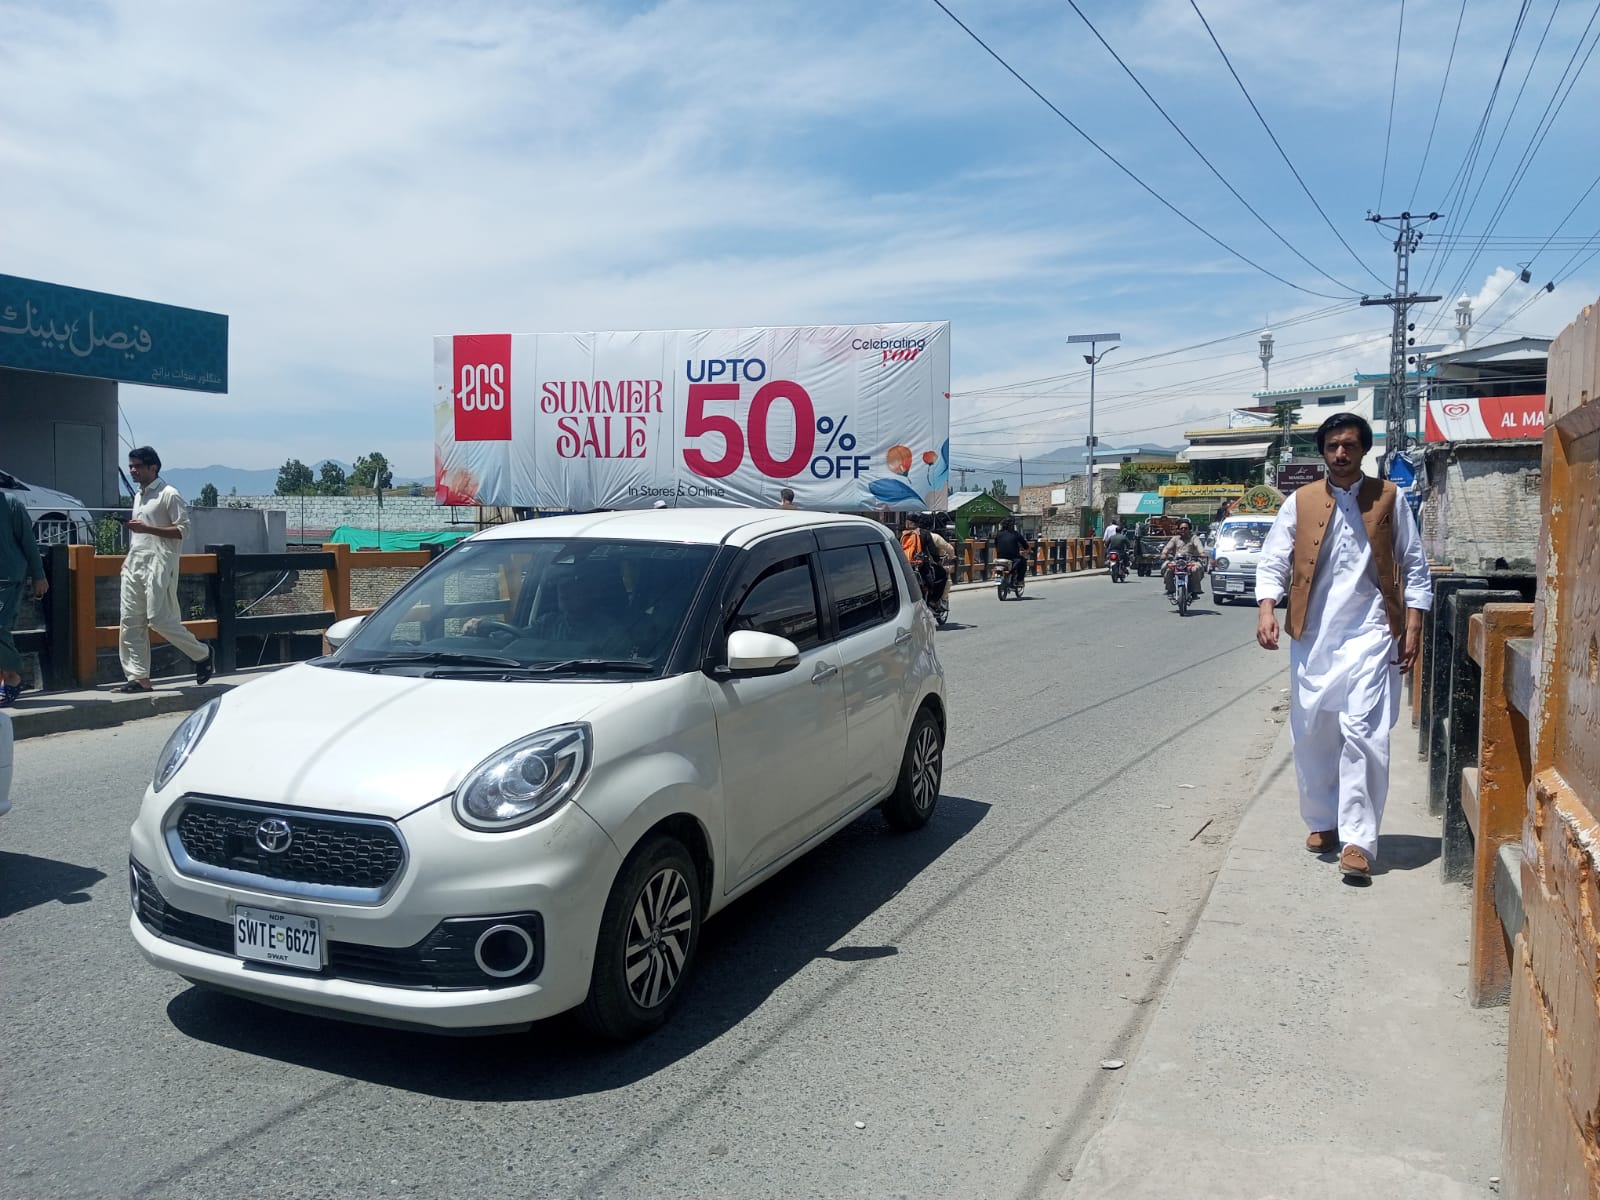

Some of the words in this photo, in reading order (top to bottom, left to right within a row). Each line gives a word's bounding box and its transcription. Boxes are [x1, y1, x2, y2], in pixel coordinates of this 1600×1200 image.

[852, 337, 925, 352] Celebrating
[686, 358, 766, 382] UPTO
[540, 379, 663, 414] SUMMER
[1501, 412, 1517, 427] AL
[556, 416, 647, 459] SALE
[810, 456, 871, 479] OFF
[628, 486, 638, 497] In
[640, 485, 675, 497] Stores
[676, 485, 685, 497] &
[687, 485, 725, 497] Online
[238, 918, 276, 949] SWTE
[285, 926, 317, 955] 6627
